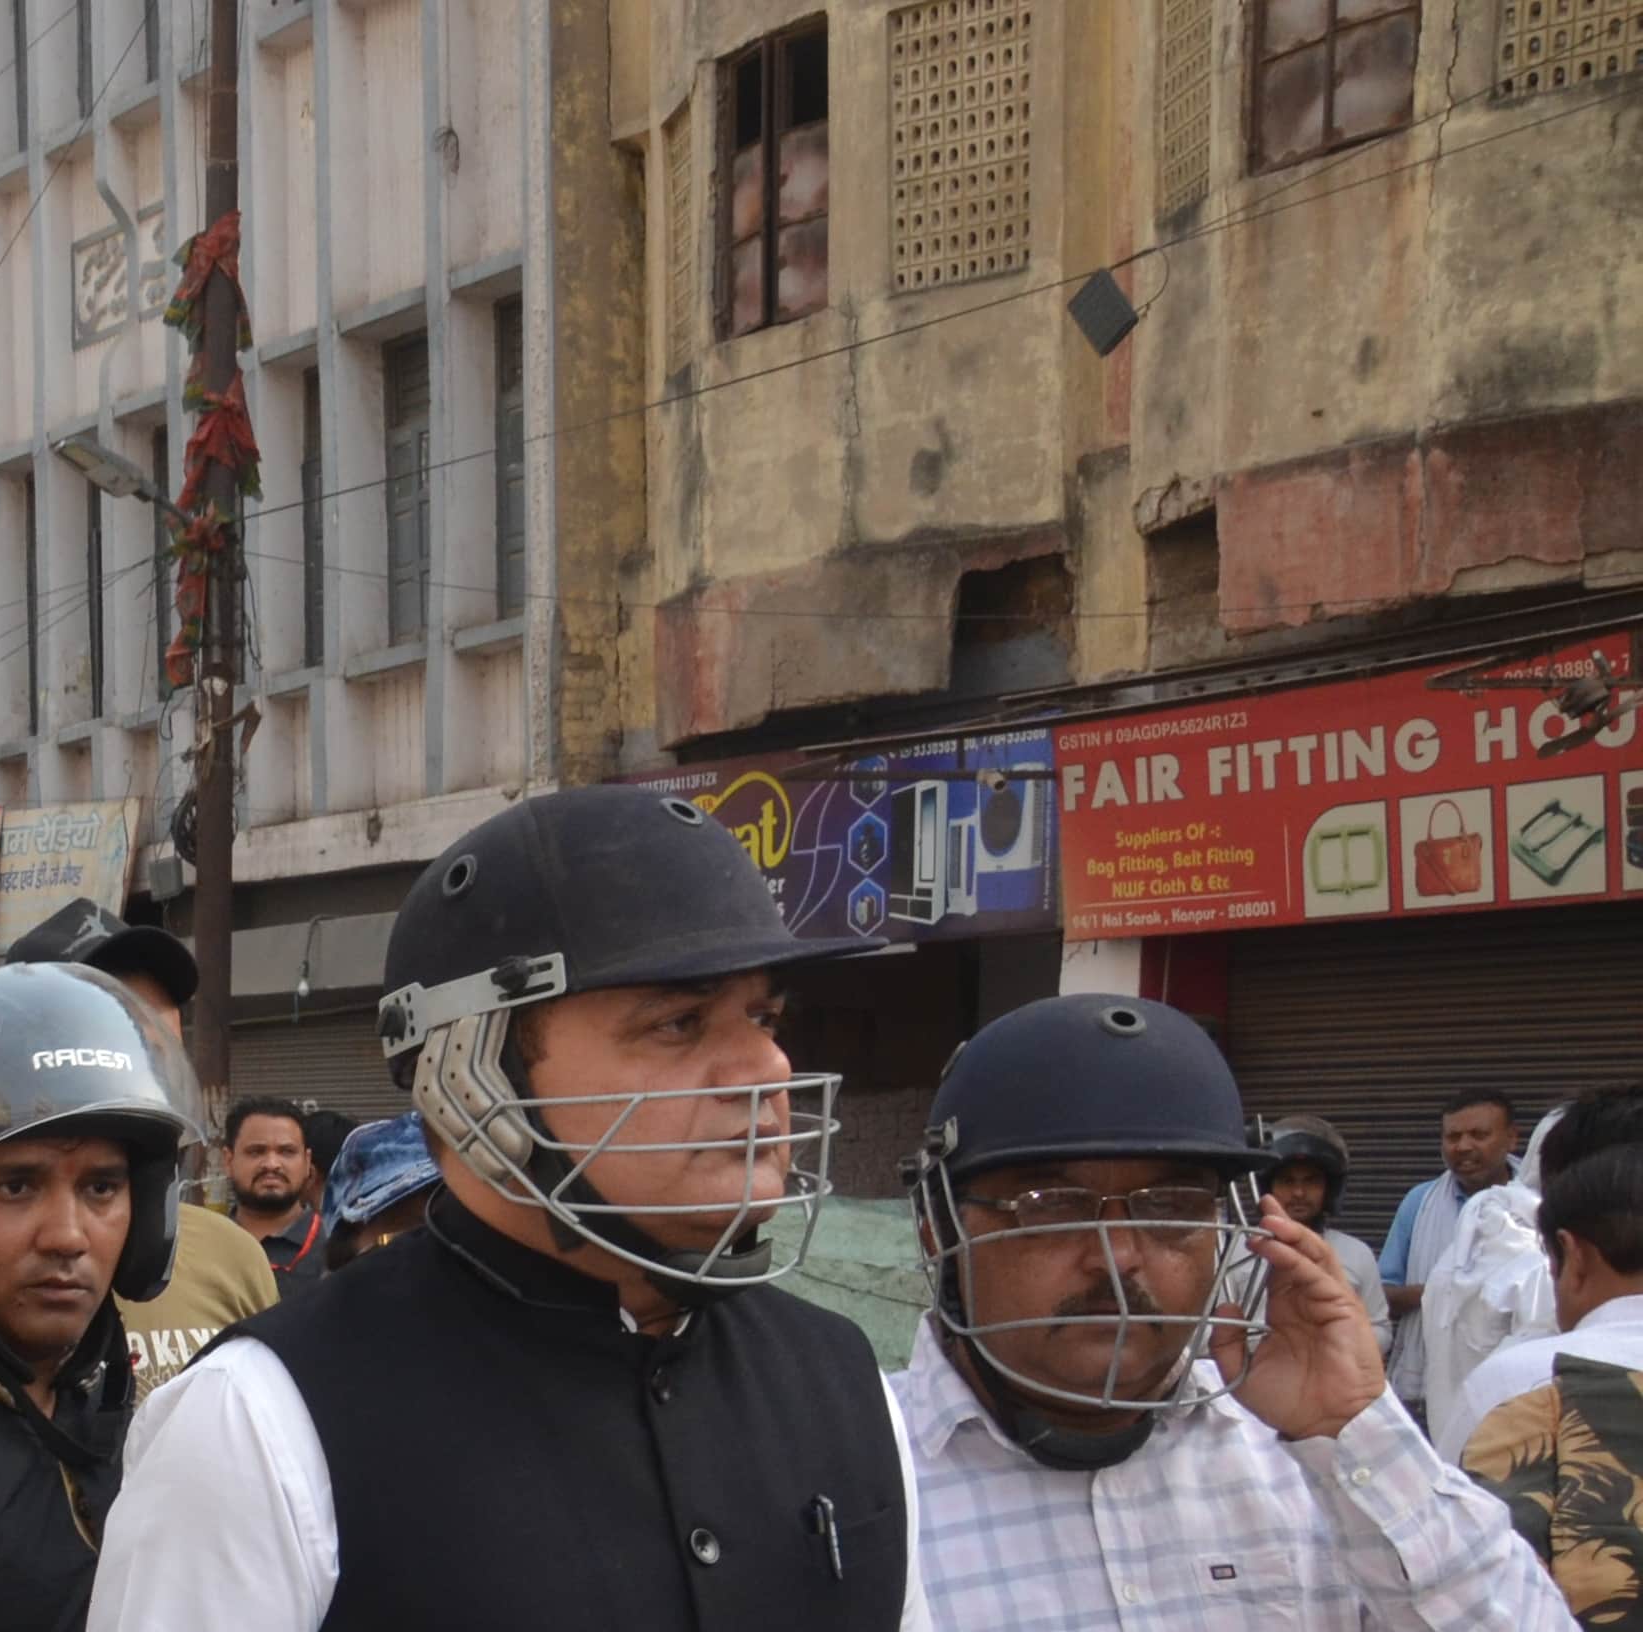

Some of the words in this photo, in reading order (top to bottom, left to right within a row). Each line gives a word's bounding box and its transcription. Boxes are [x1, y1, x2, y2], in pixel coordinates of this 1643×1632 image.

[1059, 730, 1101, 751] GSTIN
[1062, 754, 1184, 812] FAIR
[1207, 718, 1441, 797] FITTING
[1116, 826, 1183, 849] Suppliers
[1186, 823, 1206, 840] Of
[1086, 858, 1115, 878] Bag
[1119, 853, 1169, 875] Fitting,
[1173, 850, 1202, 869] Belt
[1207, 847, 1255, 867] Fitting
[1112, 880, 1146, 899] NWF
[1150, 877, 1186, 896] Cloth
[1190, 875, 1203, 892] &
[1102, 911, 1123, 928] Nai
[1125, 911, 1162, 927] Sarak
[1171, 907, 1216, 926] Kanpur
[32, 1048, 133, 1072] RACER
